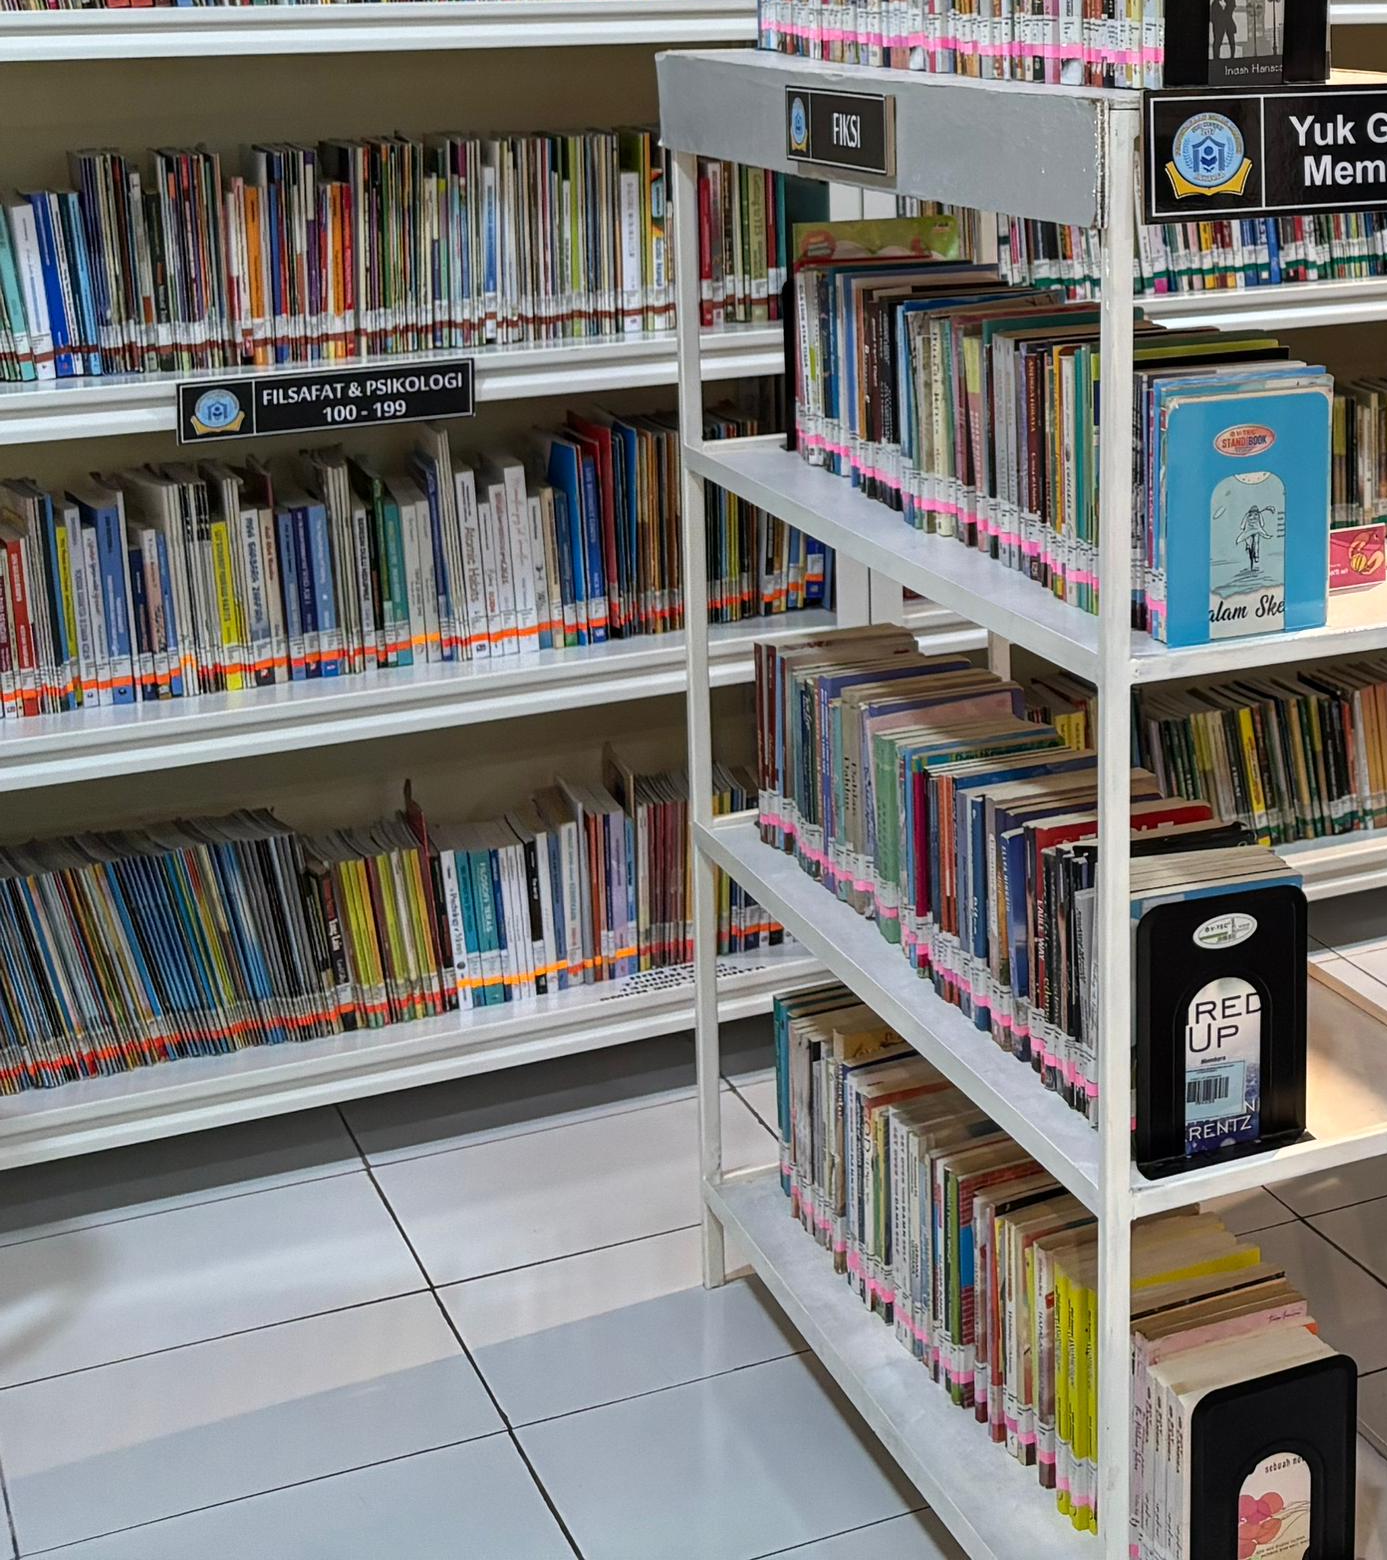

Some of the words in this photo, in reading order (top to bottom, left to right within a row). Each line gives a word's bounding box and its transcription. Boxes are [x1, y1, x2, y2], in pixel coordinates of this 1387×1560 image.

[831, 112, 861, 148] FIKSI
[1289, 115, 1356, 146] Yuk
[262, 382, 344, 406] FILSAFAT
[348, 383, 363, 398] &
[366, 372, 463, 397] PSIKOLOGI
[322, 404, 358, 422] 100
[373, 400, 407, 418] 199
[1189, 1022, 1240, 1054] UP
[1188, 1114, 1252, 1142] RENTZ
